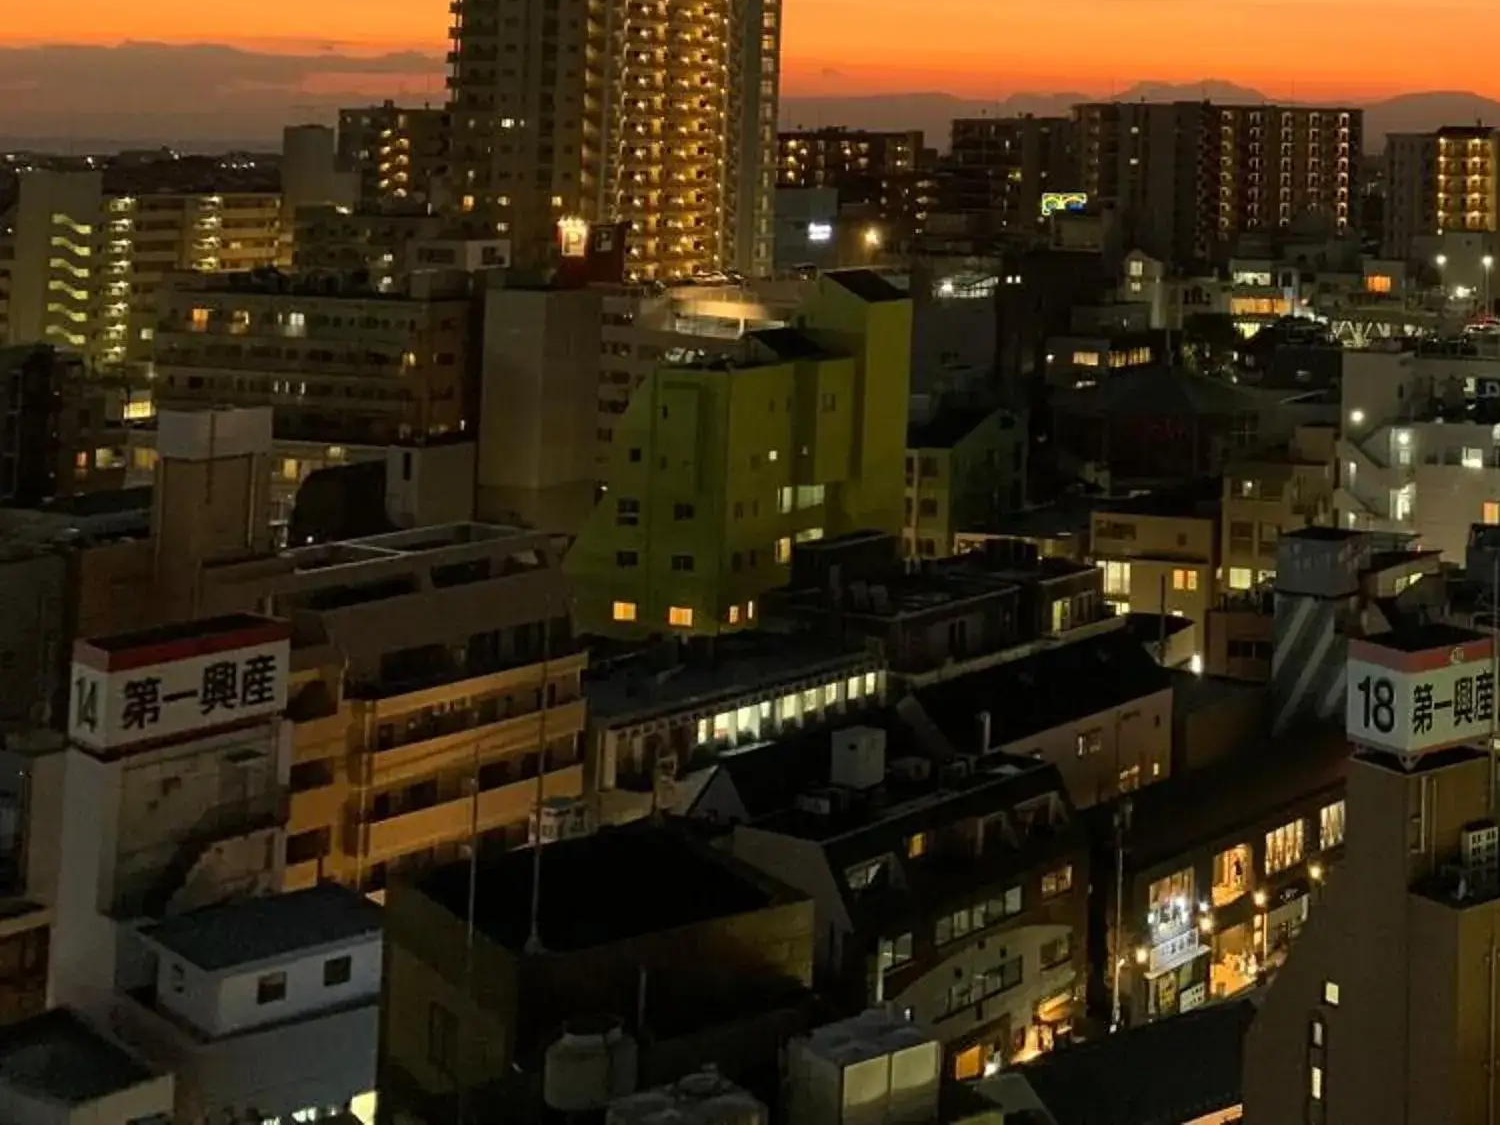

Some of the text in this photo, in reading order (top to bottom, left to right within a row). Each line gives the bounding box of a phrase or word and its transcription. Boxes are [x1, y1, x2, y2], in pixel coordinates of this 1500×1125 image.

[75, 676, 97, 732] 14
[121, 654, 278, 730] 第一興産
[1357, 675, 1395, 733] 18
